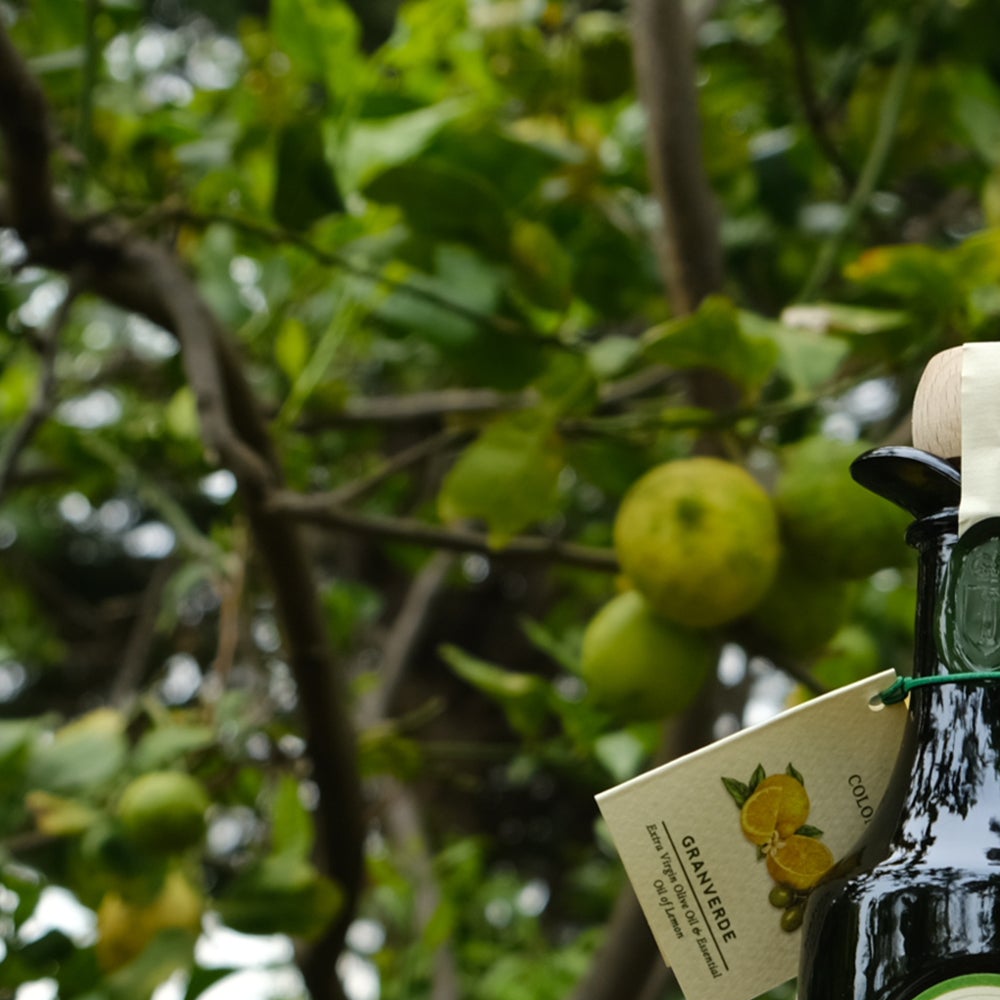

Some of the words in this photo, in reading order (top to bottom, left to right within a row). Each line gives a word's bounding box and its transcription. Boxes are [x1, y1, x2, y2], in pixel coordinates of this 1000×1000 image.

[646, 824, 663, 852] Extra
[660, 852, 677, 883] Virgin
[653, 879, 668, 895] Oil
[673, 884, 689, 909] Olive
[682, 835, 737, 943] GRANVERDE
[659, 897, 673, 906] of
[665, 907, 684, 939] Lemon
[684, 910, 699, 926] Oil
[692, 927, 702, 936] &
[696, 937, 722, 979] Essential
